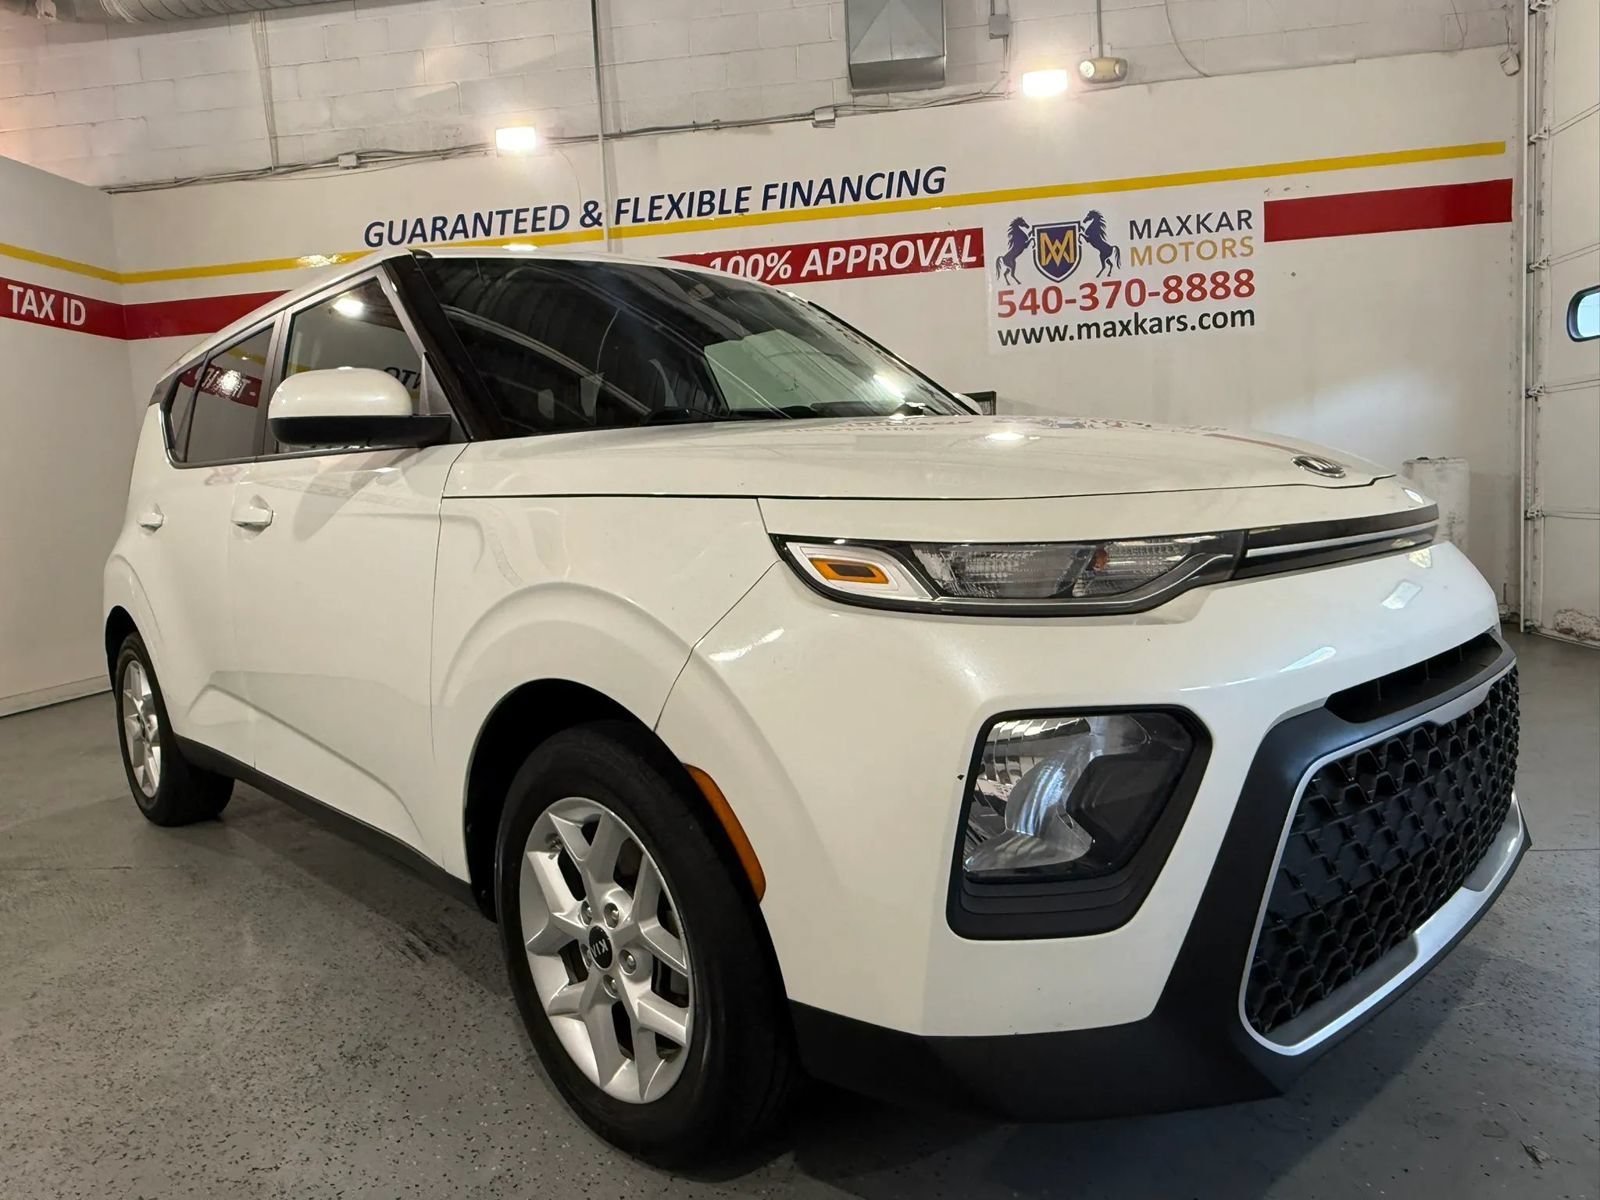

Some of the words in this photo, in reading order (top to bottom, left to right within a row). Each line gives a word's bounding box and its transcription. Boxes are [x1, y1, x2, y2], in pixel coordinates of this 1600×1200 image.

[365, 205, 570, 247] GUARANTEED
[580, 201, 603, 228] &
[614, 186, 752, 226] FLEXIBLE
[762, 166, 947, 211] FINANCING
[1129, 209, 1254, 241] MAXKAR
[800, 234, 978, 278] APPROVAL
[1130, 236, 1254, 267] MOTORS
[7, 284, 56, 321] TAX
[62, 296, 86, 326] ID
[997, 269, 1255, 318] 540-370-8888
[998, 308, 1255, 346] www.maxkars.com
